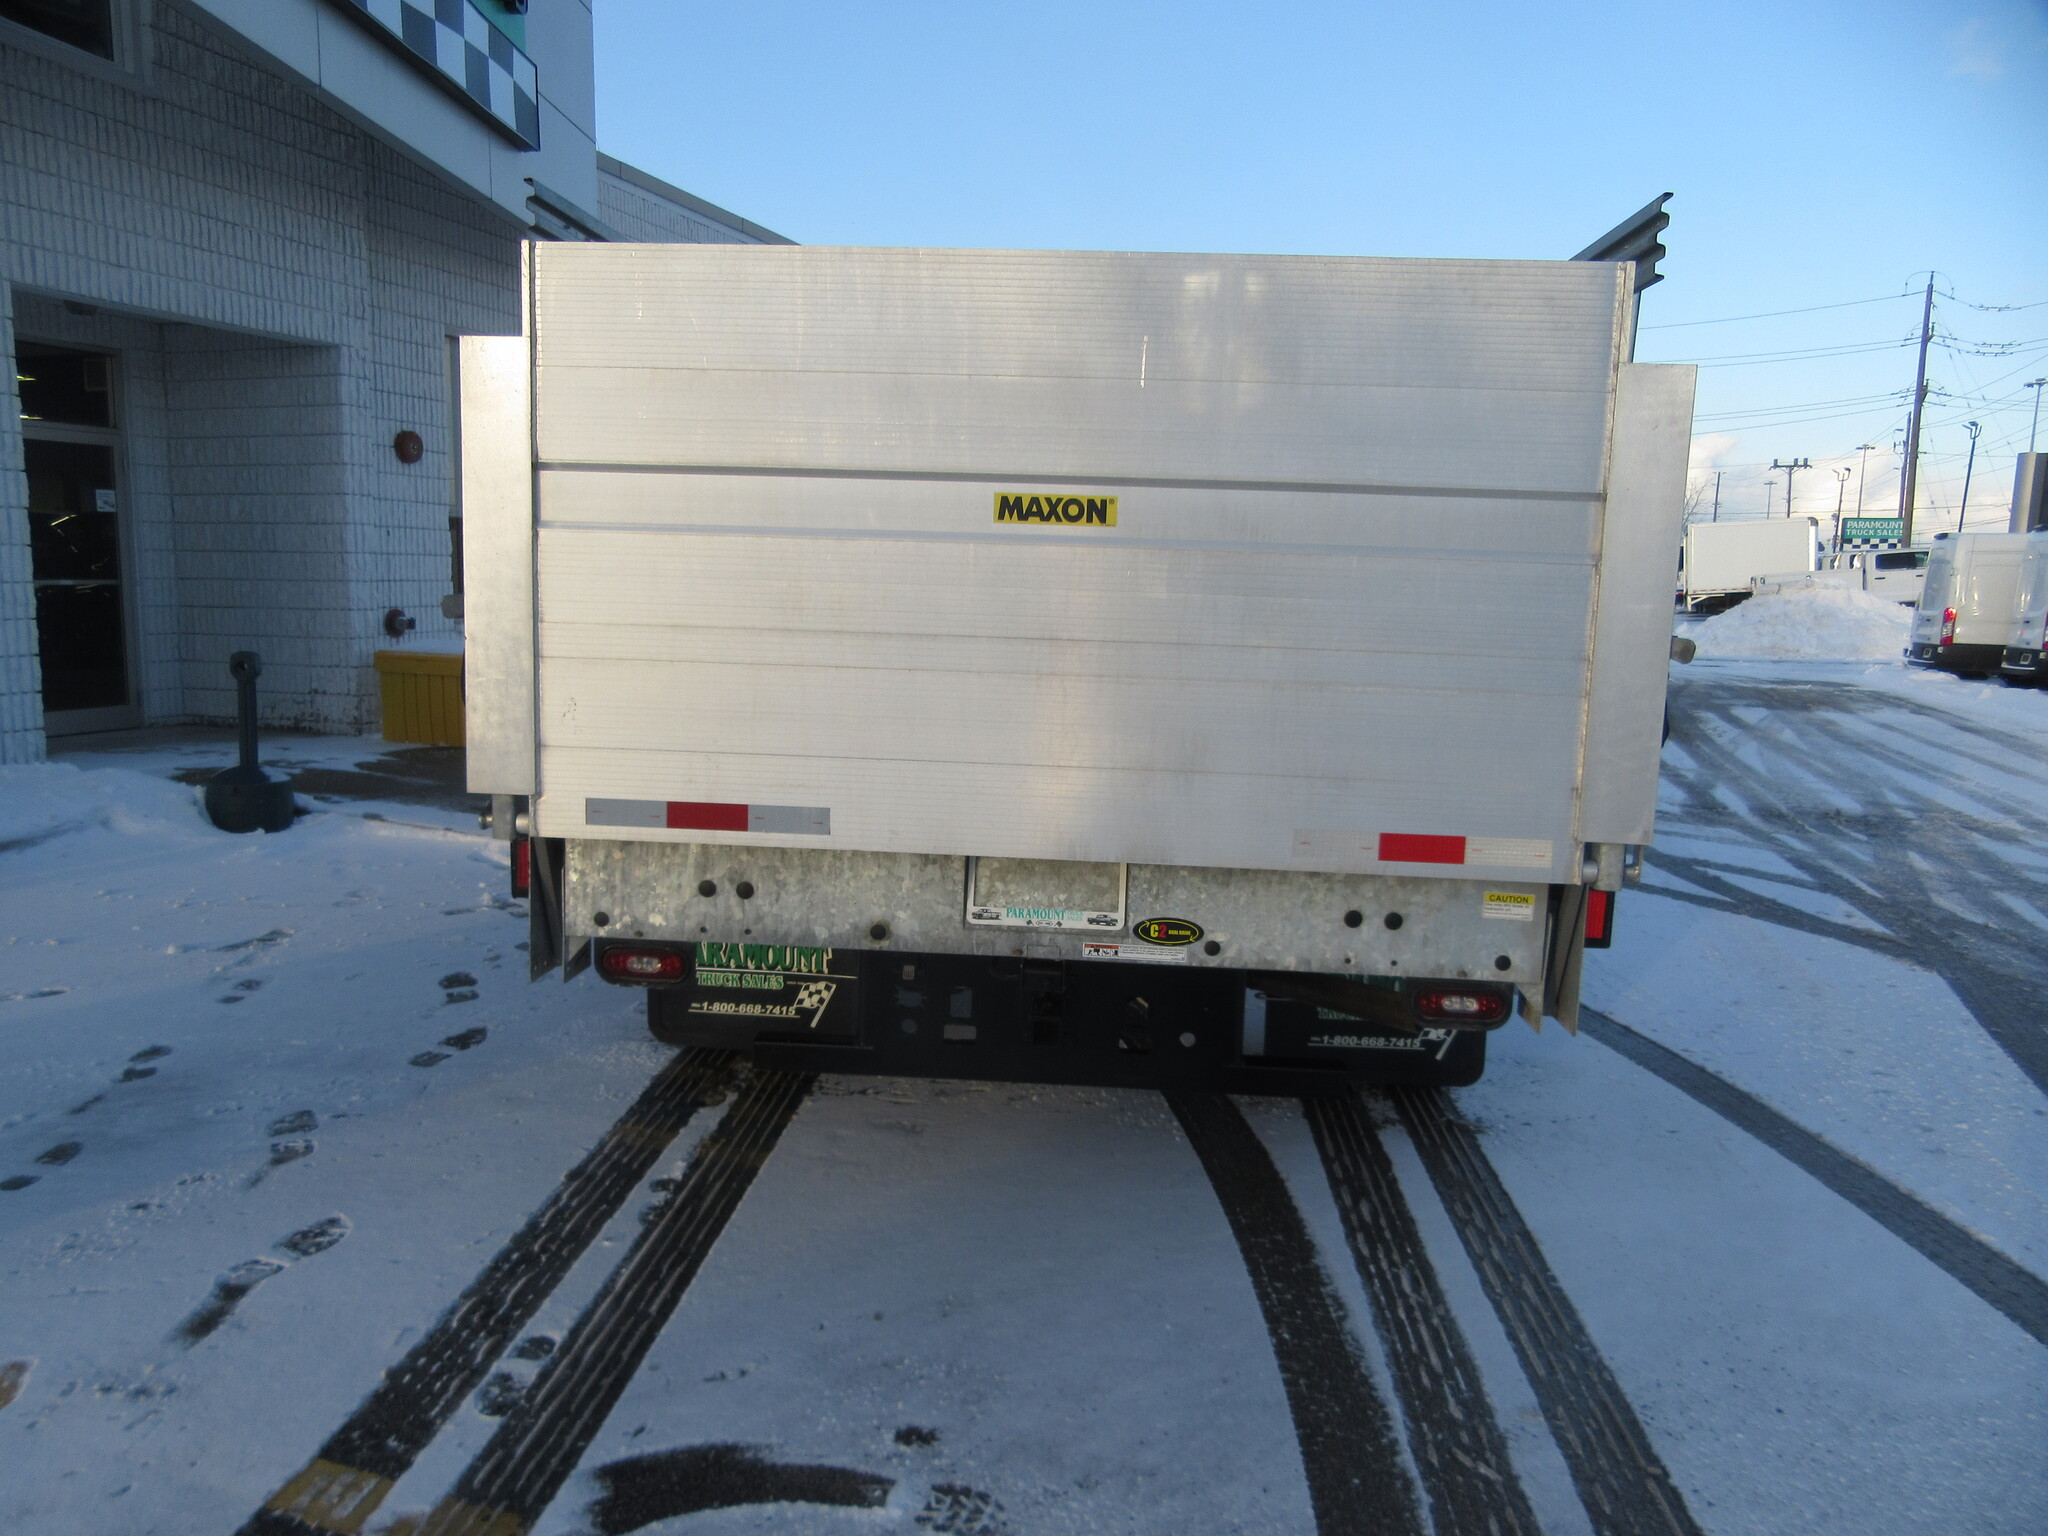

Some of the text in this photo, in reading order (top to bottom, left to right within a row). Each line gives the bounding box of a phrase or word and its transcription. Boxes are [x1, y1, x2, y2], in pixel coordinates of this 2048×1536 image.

[998, 495, 1108, 524] MAXON
[1489, 894, 1529, 904] CAUTION
[1006, 907, 1067, 921] PARAMOUNT
[1150, 924, 1167, 938] C2
[696, 971, 784, 990] TRUCK SALES
[702, 1001, 796, 1016] 1-800-668-7415
[1321, 1035, 1421, 1048] 1-800-668-7415
